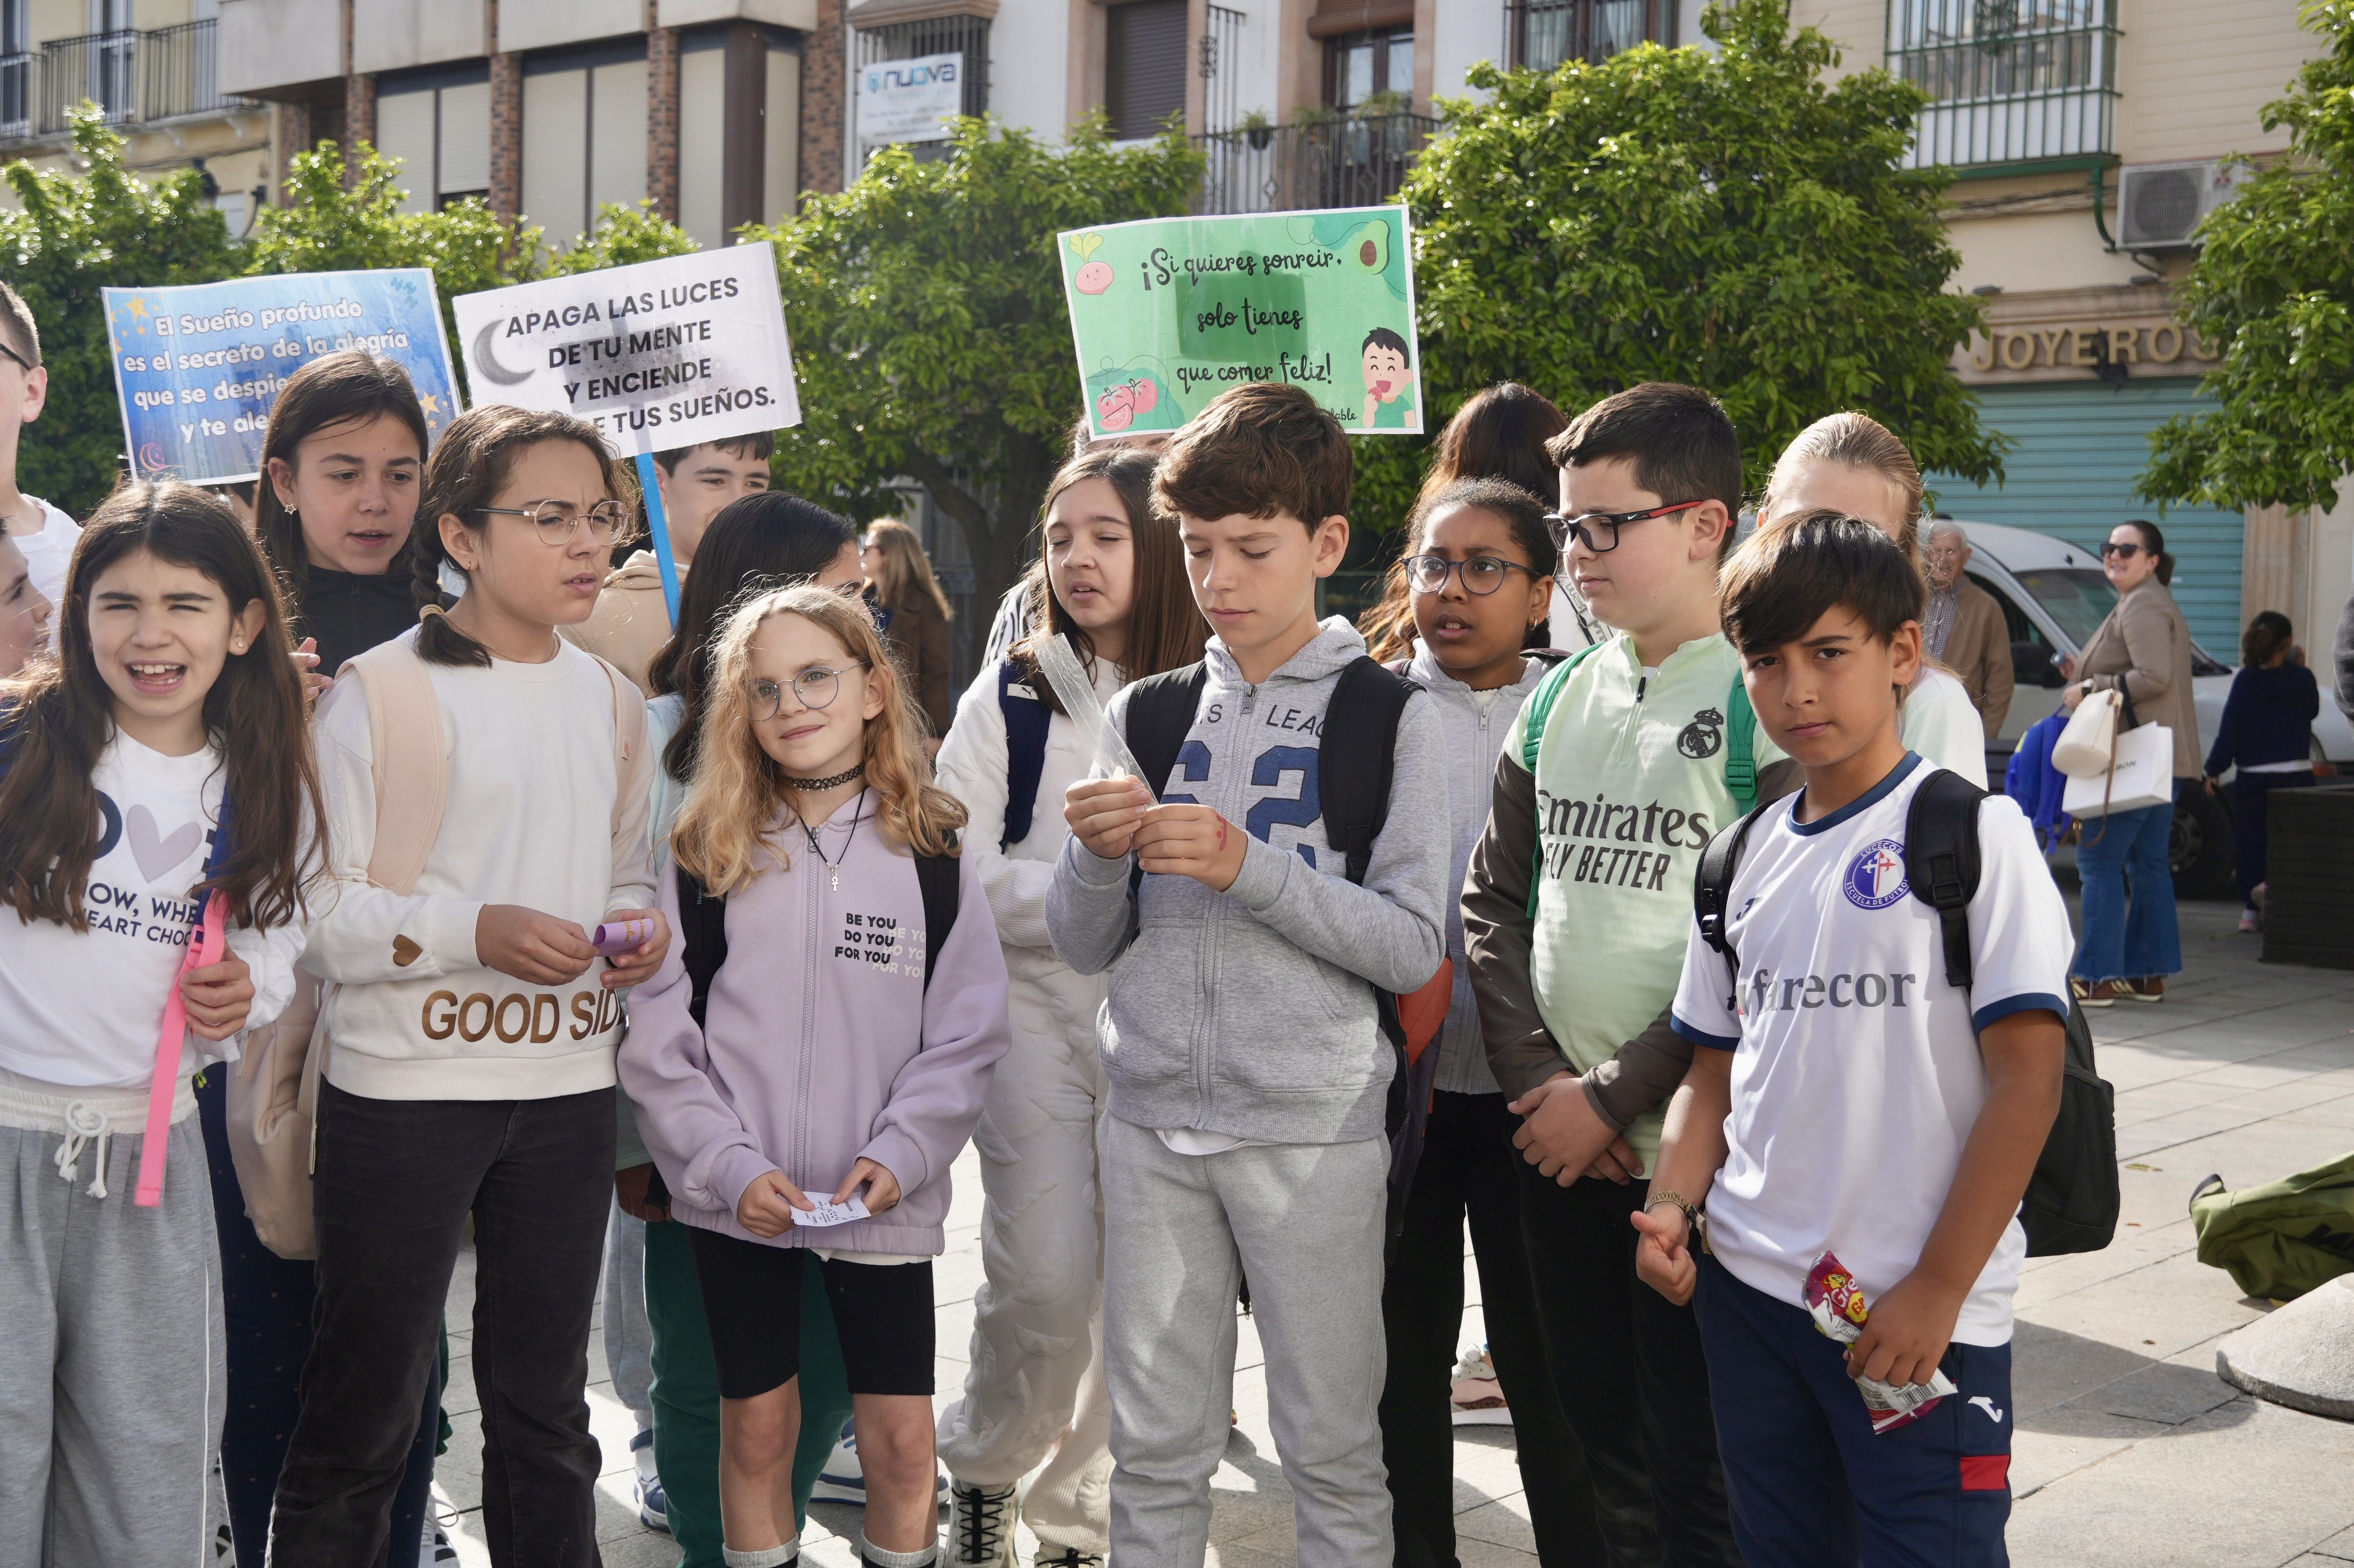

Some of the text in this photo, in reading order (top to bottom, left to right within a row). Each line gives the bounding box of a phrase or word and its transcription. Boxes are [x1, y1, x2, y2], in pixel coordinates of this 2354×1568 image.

[1141, 248, 1342, 291] ¡Si quieres sonreir,
[155, 297, 364, 337] El Sueño profundo
[506, 277, 738, 338] APAGA LAS LUCES
[1197, 297, 1304, 335] solo tienes
[123, 326, 409, 373] es el secreto de la alegría
[549, 320, 711, 369] DE TU MENTE
[563, 358, 711, 404] Y ENCIENDE
[1176, 352, 1333, 395] que comer feliz!
[133, 389, 176, 412] que
[181, 386, 207, 405] se
[613, 406, 663, 433] TUS
[670, 387, 776, 423] SUEÑOS.
[180, 422, 195, 444] y
[200, 417, 227, 438] te
[1574, 845, 1671, 891] BETTER
[1860, 842, 1902, 858] LUCECOR
[83, 879, 140, 917] OW,
[1846, 881, 1870, 905] ESCUELA
[83, 908, 142, 937] EART
[844, 930, 895, 947] DO YOU
[846, 913, 897, 930] BE YOU
[834, 946, 891, 964] FOR YOU
[908, 947, 926, 961] YO
[422, 990, 560, 1043] GOOD
